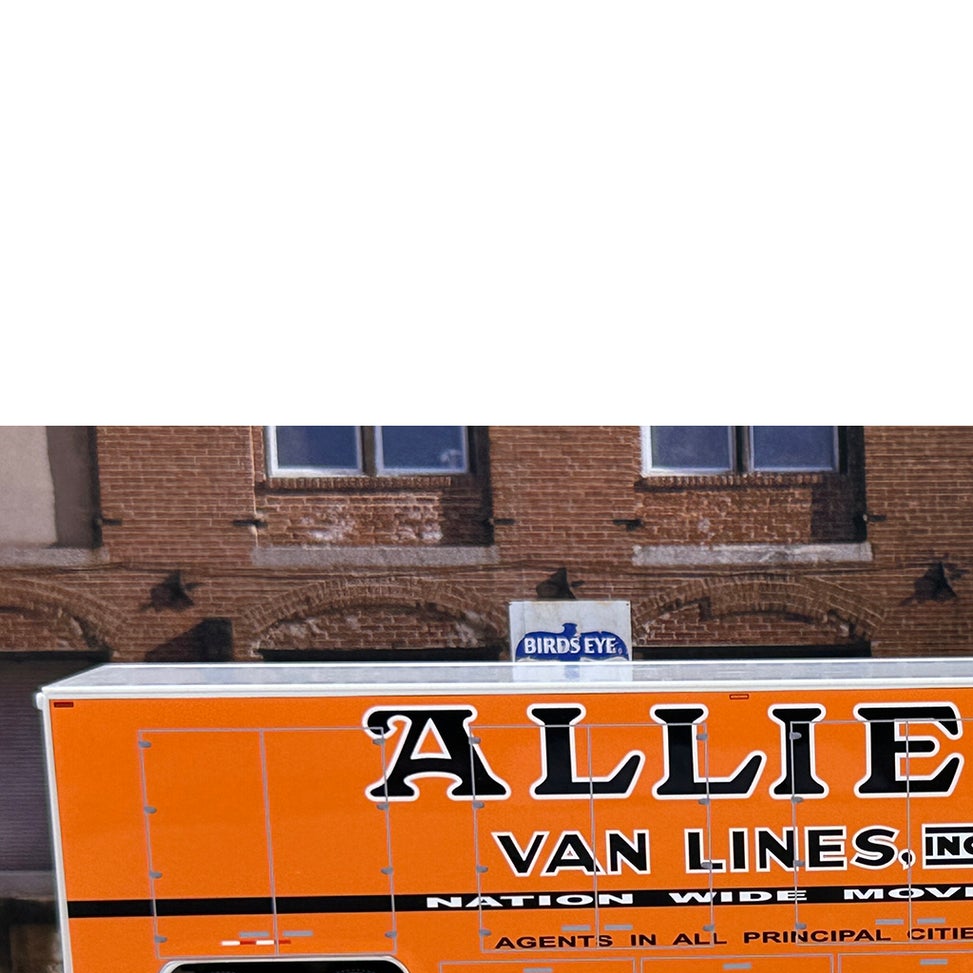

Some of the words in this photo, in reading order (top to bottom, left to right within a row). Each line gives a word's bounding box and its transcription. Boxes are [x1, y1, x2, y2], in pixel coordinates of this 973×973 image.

[583, 636, 618, 654] EYE
[490, 828, 651, 878] VAN
[426, 892, 634, 909] NATION
[668, 889, 807, 904] WIDE
[494, 934, 614, 950] AGENTS
[629, 933, 657, 947] IN
[672, 931, 728, 946] ALL
[743, 928, 892, 944] PRINCIPAL
